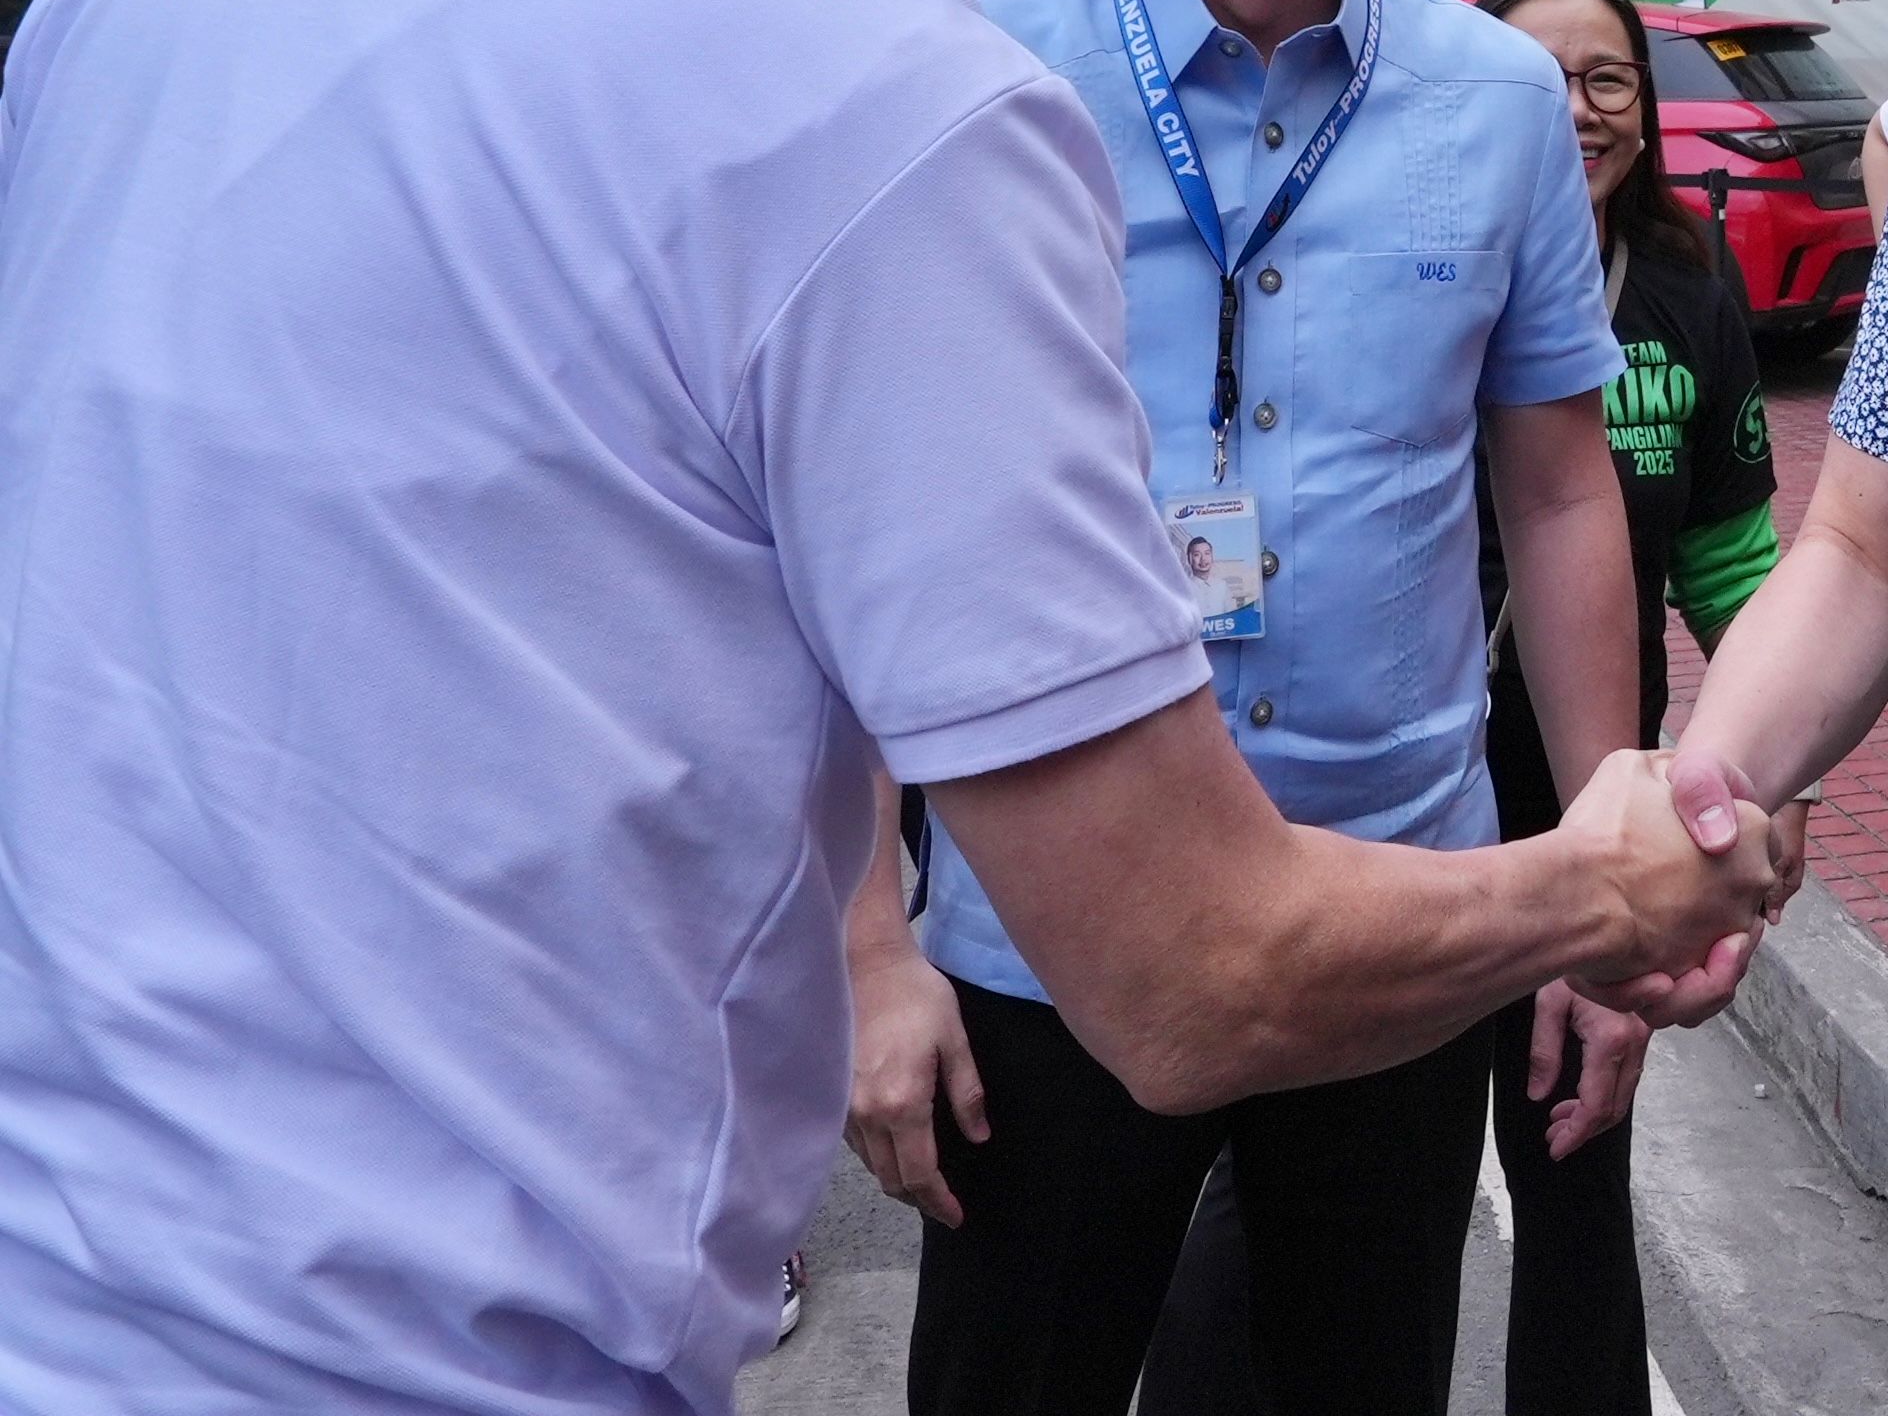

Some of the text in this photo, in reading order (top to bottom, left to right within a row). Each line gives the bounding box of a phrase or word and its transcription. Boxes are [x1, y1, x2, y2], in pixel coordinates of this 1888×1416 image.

[1156, 111, 1200, 179] CITY
[1291, 121, 1337, 186] Tuloy
[1416, 262, 1457, 282] WES
[1621, 340, 1668, 365] TEAM
[1601, 364, 1696, 425] KIKO
[1633, 449, 1675, 476] 2025
